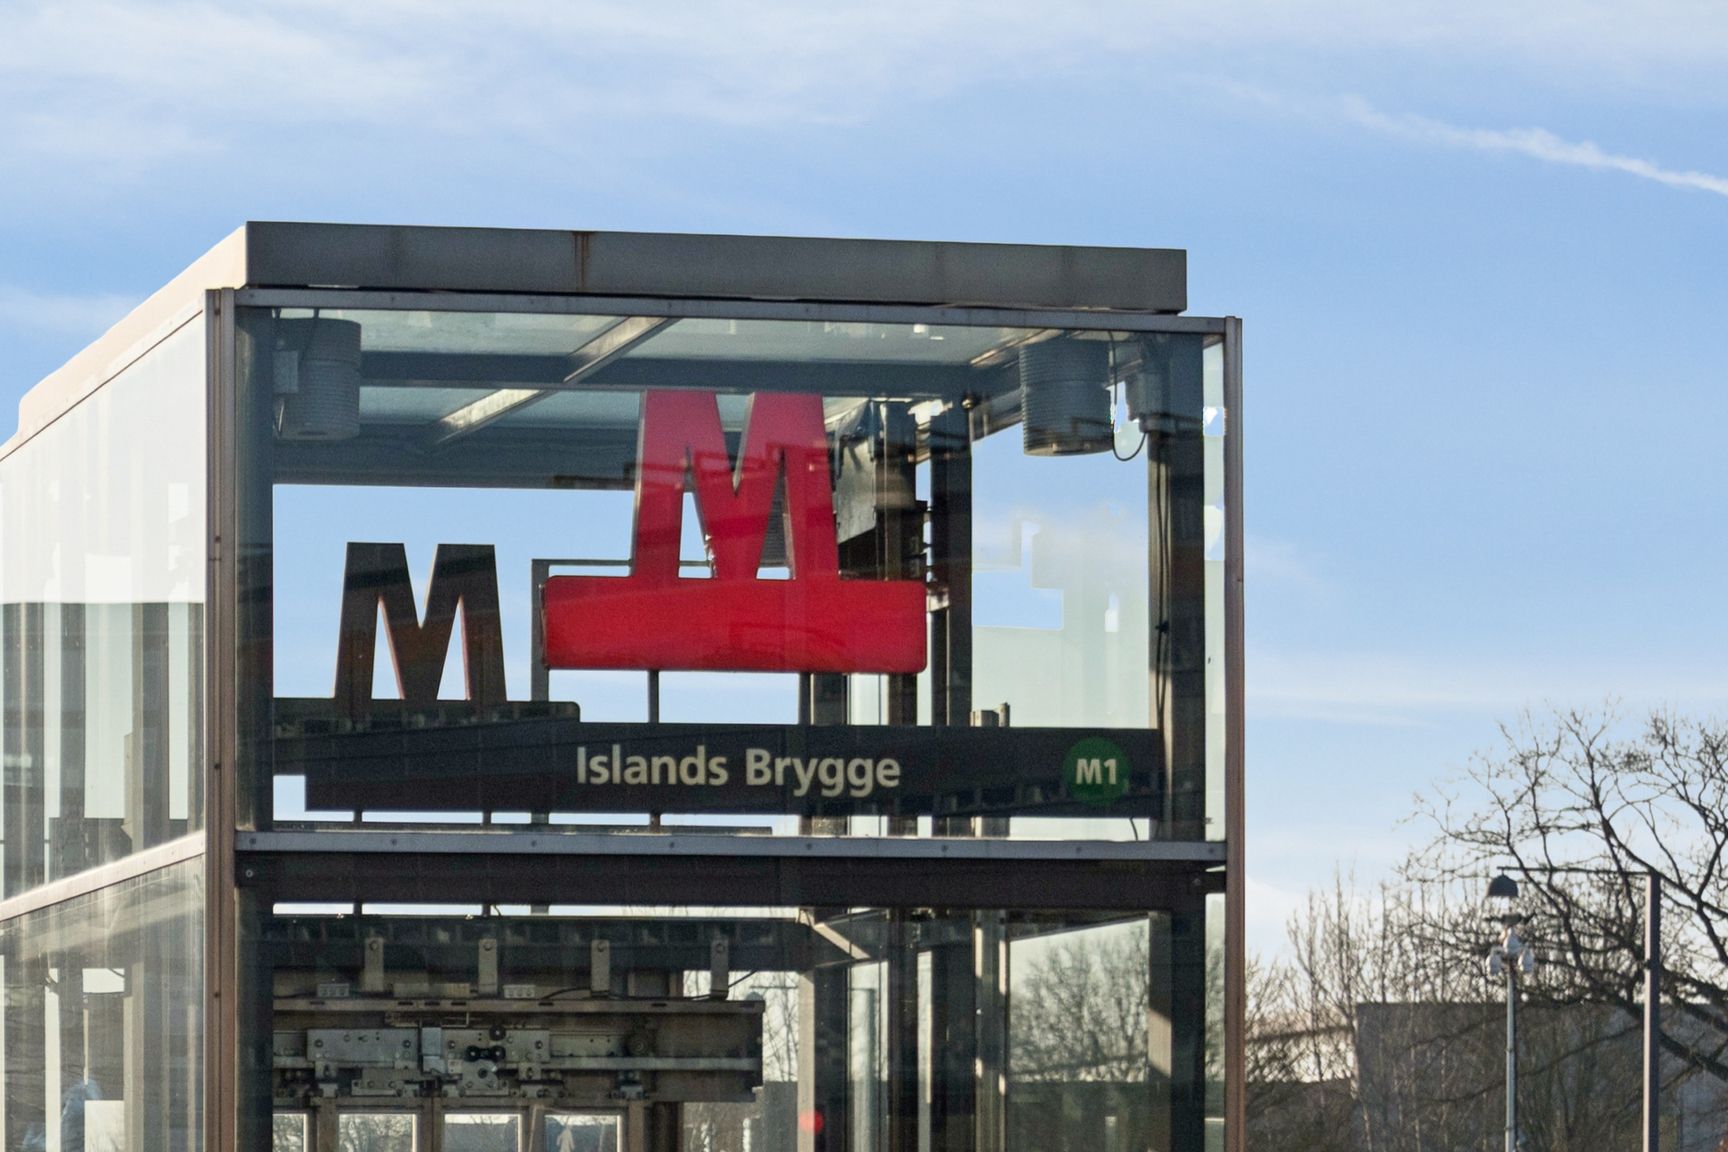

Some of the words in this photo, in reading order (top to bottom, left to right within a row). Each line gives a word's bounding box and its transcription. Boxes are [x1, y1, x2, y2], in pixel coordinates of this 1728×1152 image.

[629, 388, 839, 580] M
[334, 541, 508, 702] M
[576, 744, 729, 786] Islands
[745, 747, 901, 798] Brygge
[1075, 758, 1117, 785] M1
